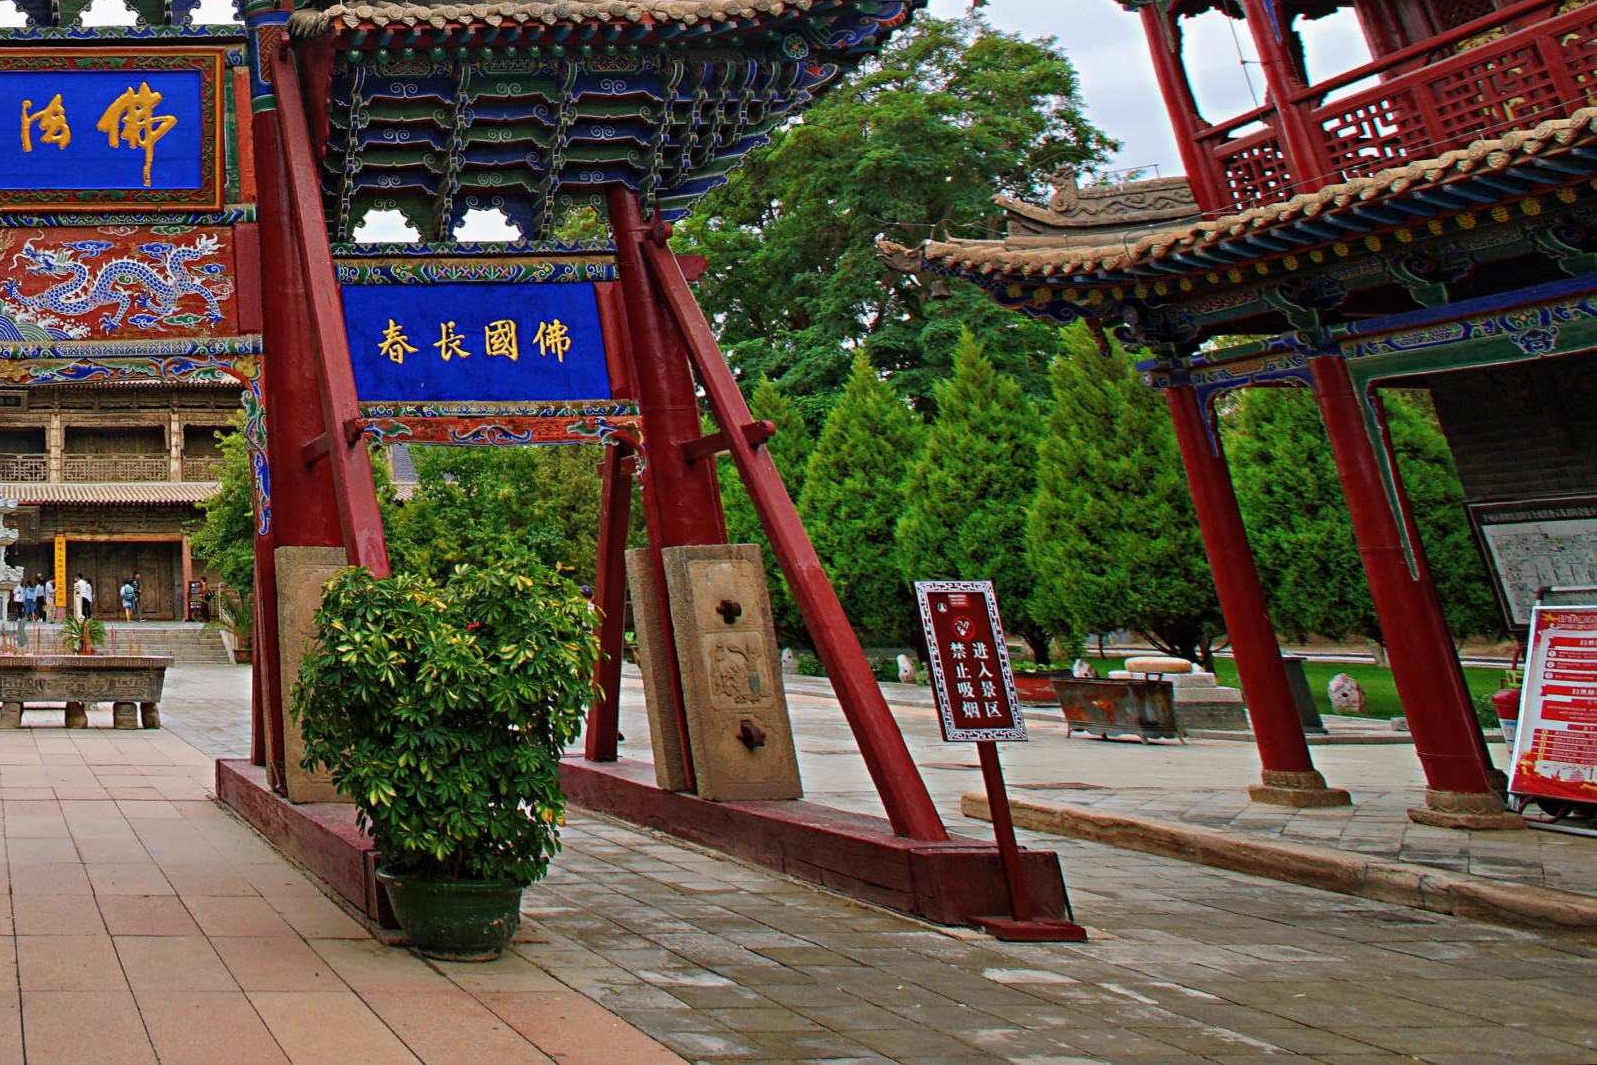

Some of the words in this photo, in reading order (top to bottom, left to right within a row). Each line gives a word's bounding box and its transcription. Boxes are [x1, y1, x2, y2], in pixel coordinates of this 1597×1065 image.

[378, 318, 572, 365] 佛國長春
[949, 641, 980, 719] 禁止吸烟
[972, 642, 1002, 718] 进入景区
